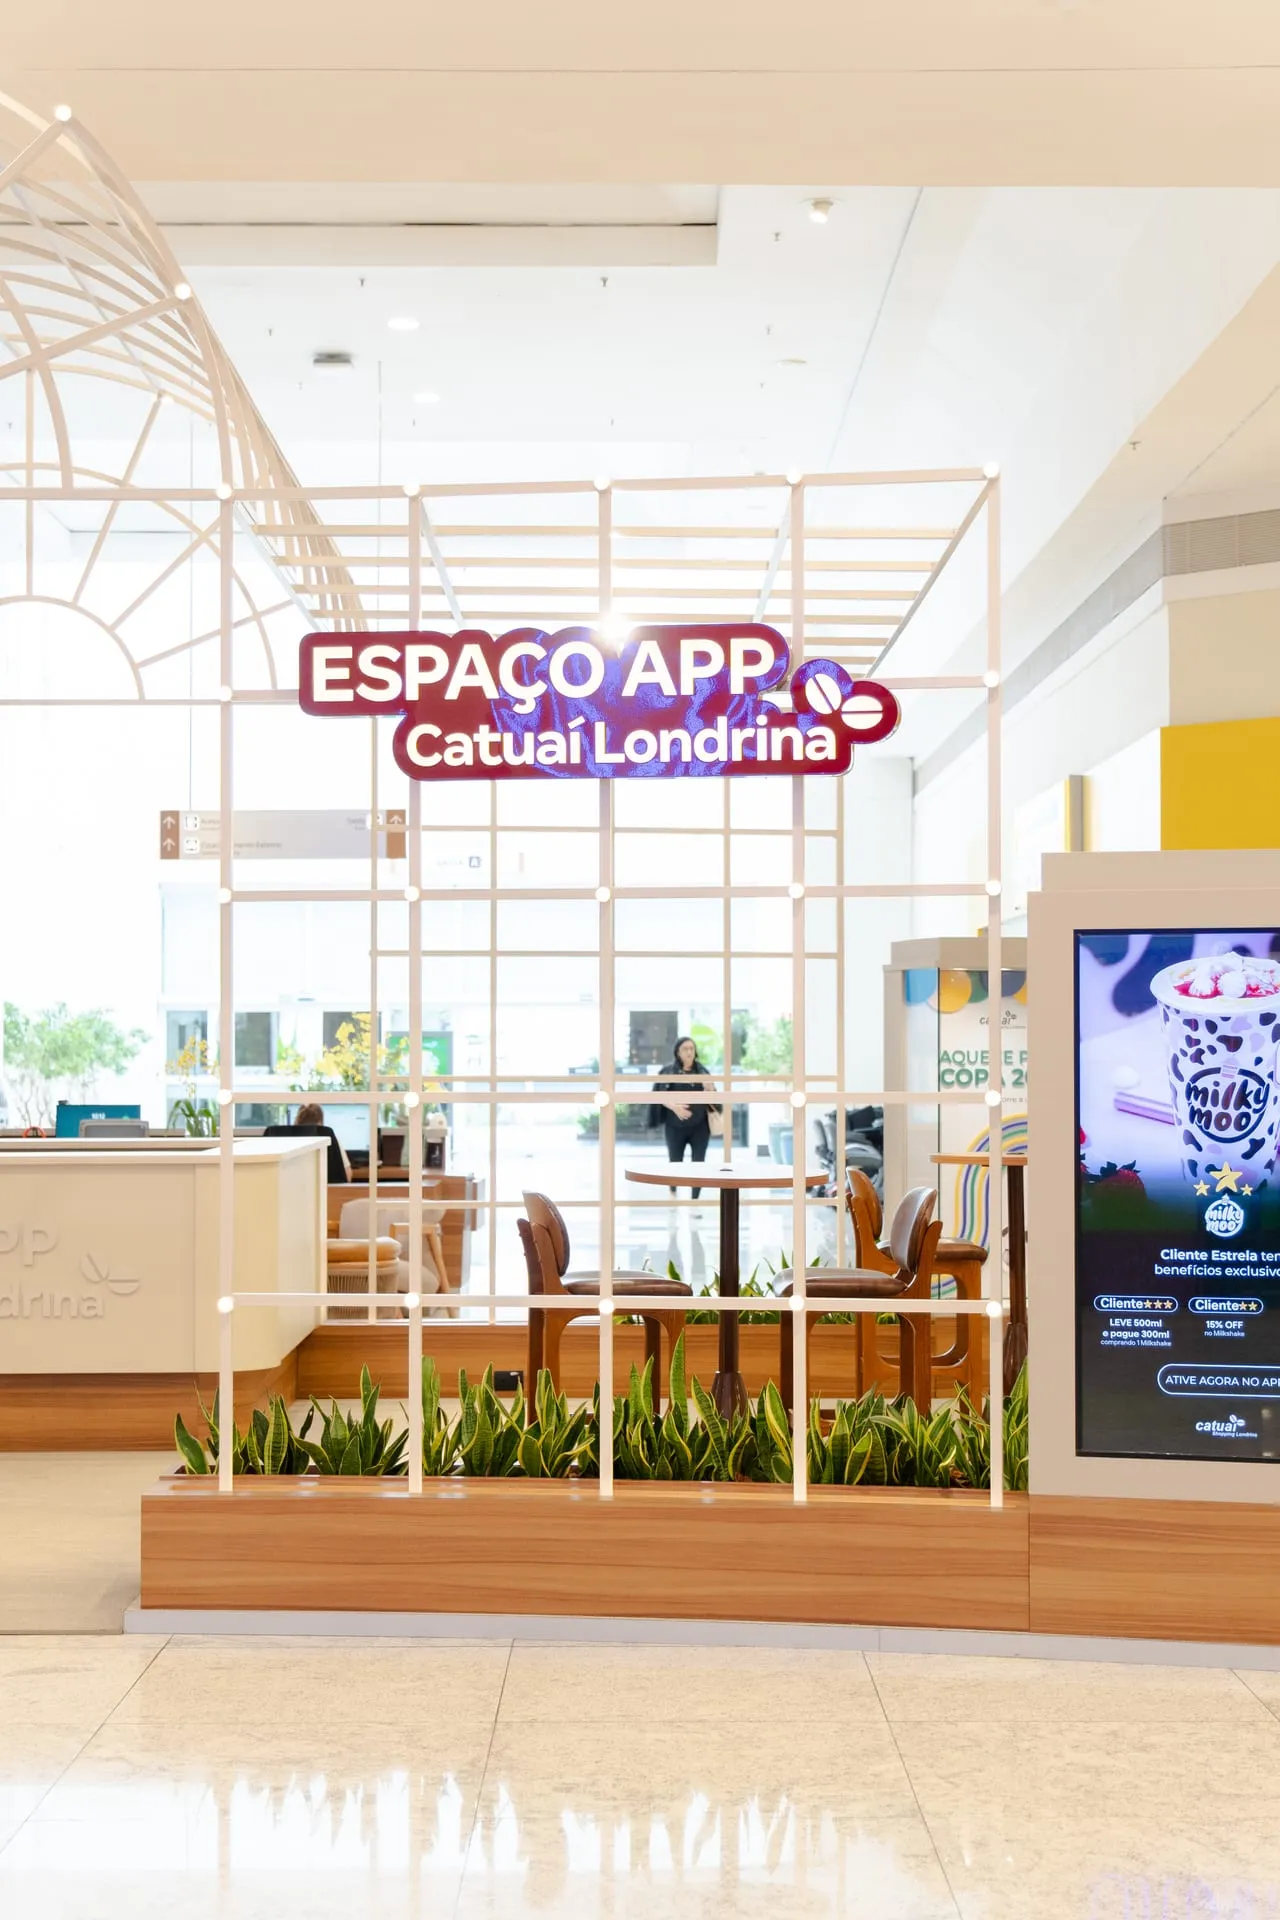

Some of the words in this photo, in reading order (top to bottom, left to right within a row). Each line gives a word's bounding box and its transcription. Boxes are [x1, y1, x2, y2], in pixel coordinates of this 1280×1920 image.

[312, 641, 604, 714] ESPAÇO
[621, 639, 775, 696] APP
[406, 717, 581, 767] Catuaí
[595, 715, 836, 764] Londrina
[941, 1068, 1006, 1087] COP
[1185, 1079, 1270, 1114] milky
[1189, 1105, 1251, 1132] moo
[1160, 1249, 1208, 1260] Cliente
[1211, 1250, 1258, 1261] Estrela
[1154, 1264, 1222, 1276] benefícios
[1100, 1298, 1143, 1309] Cliente
[1195, 1299, 1240, 1310] Cliente
[1109, 1318, 1132, 1327] LEVE
[1134, 1319, 1162, 1327] 500ml
[1205, 1320, 1223, 1328] 15%
[1225, 1321, 1243, 1329] OFF
[1110, 1331, 1140, 1339] pague
[1141, 1330, 1170, 1338] 300ml
[1165, 1375, 1197, 1385] ATIVE
[1199, 1376, 1240, 1386] AGORA
[1242, 1376, 1260, 1386] NO
[1261, 1377, 1280, 1387] AP
